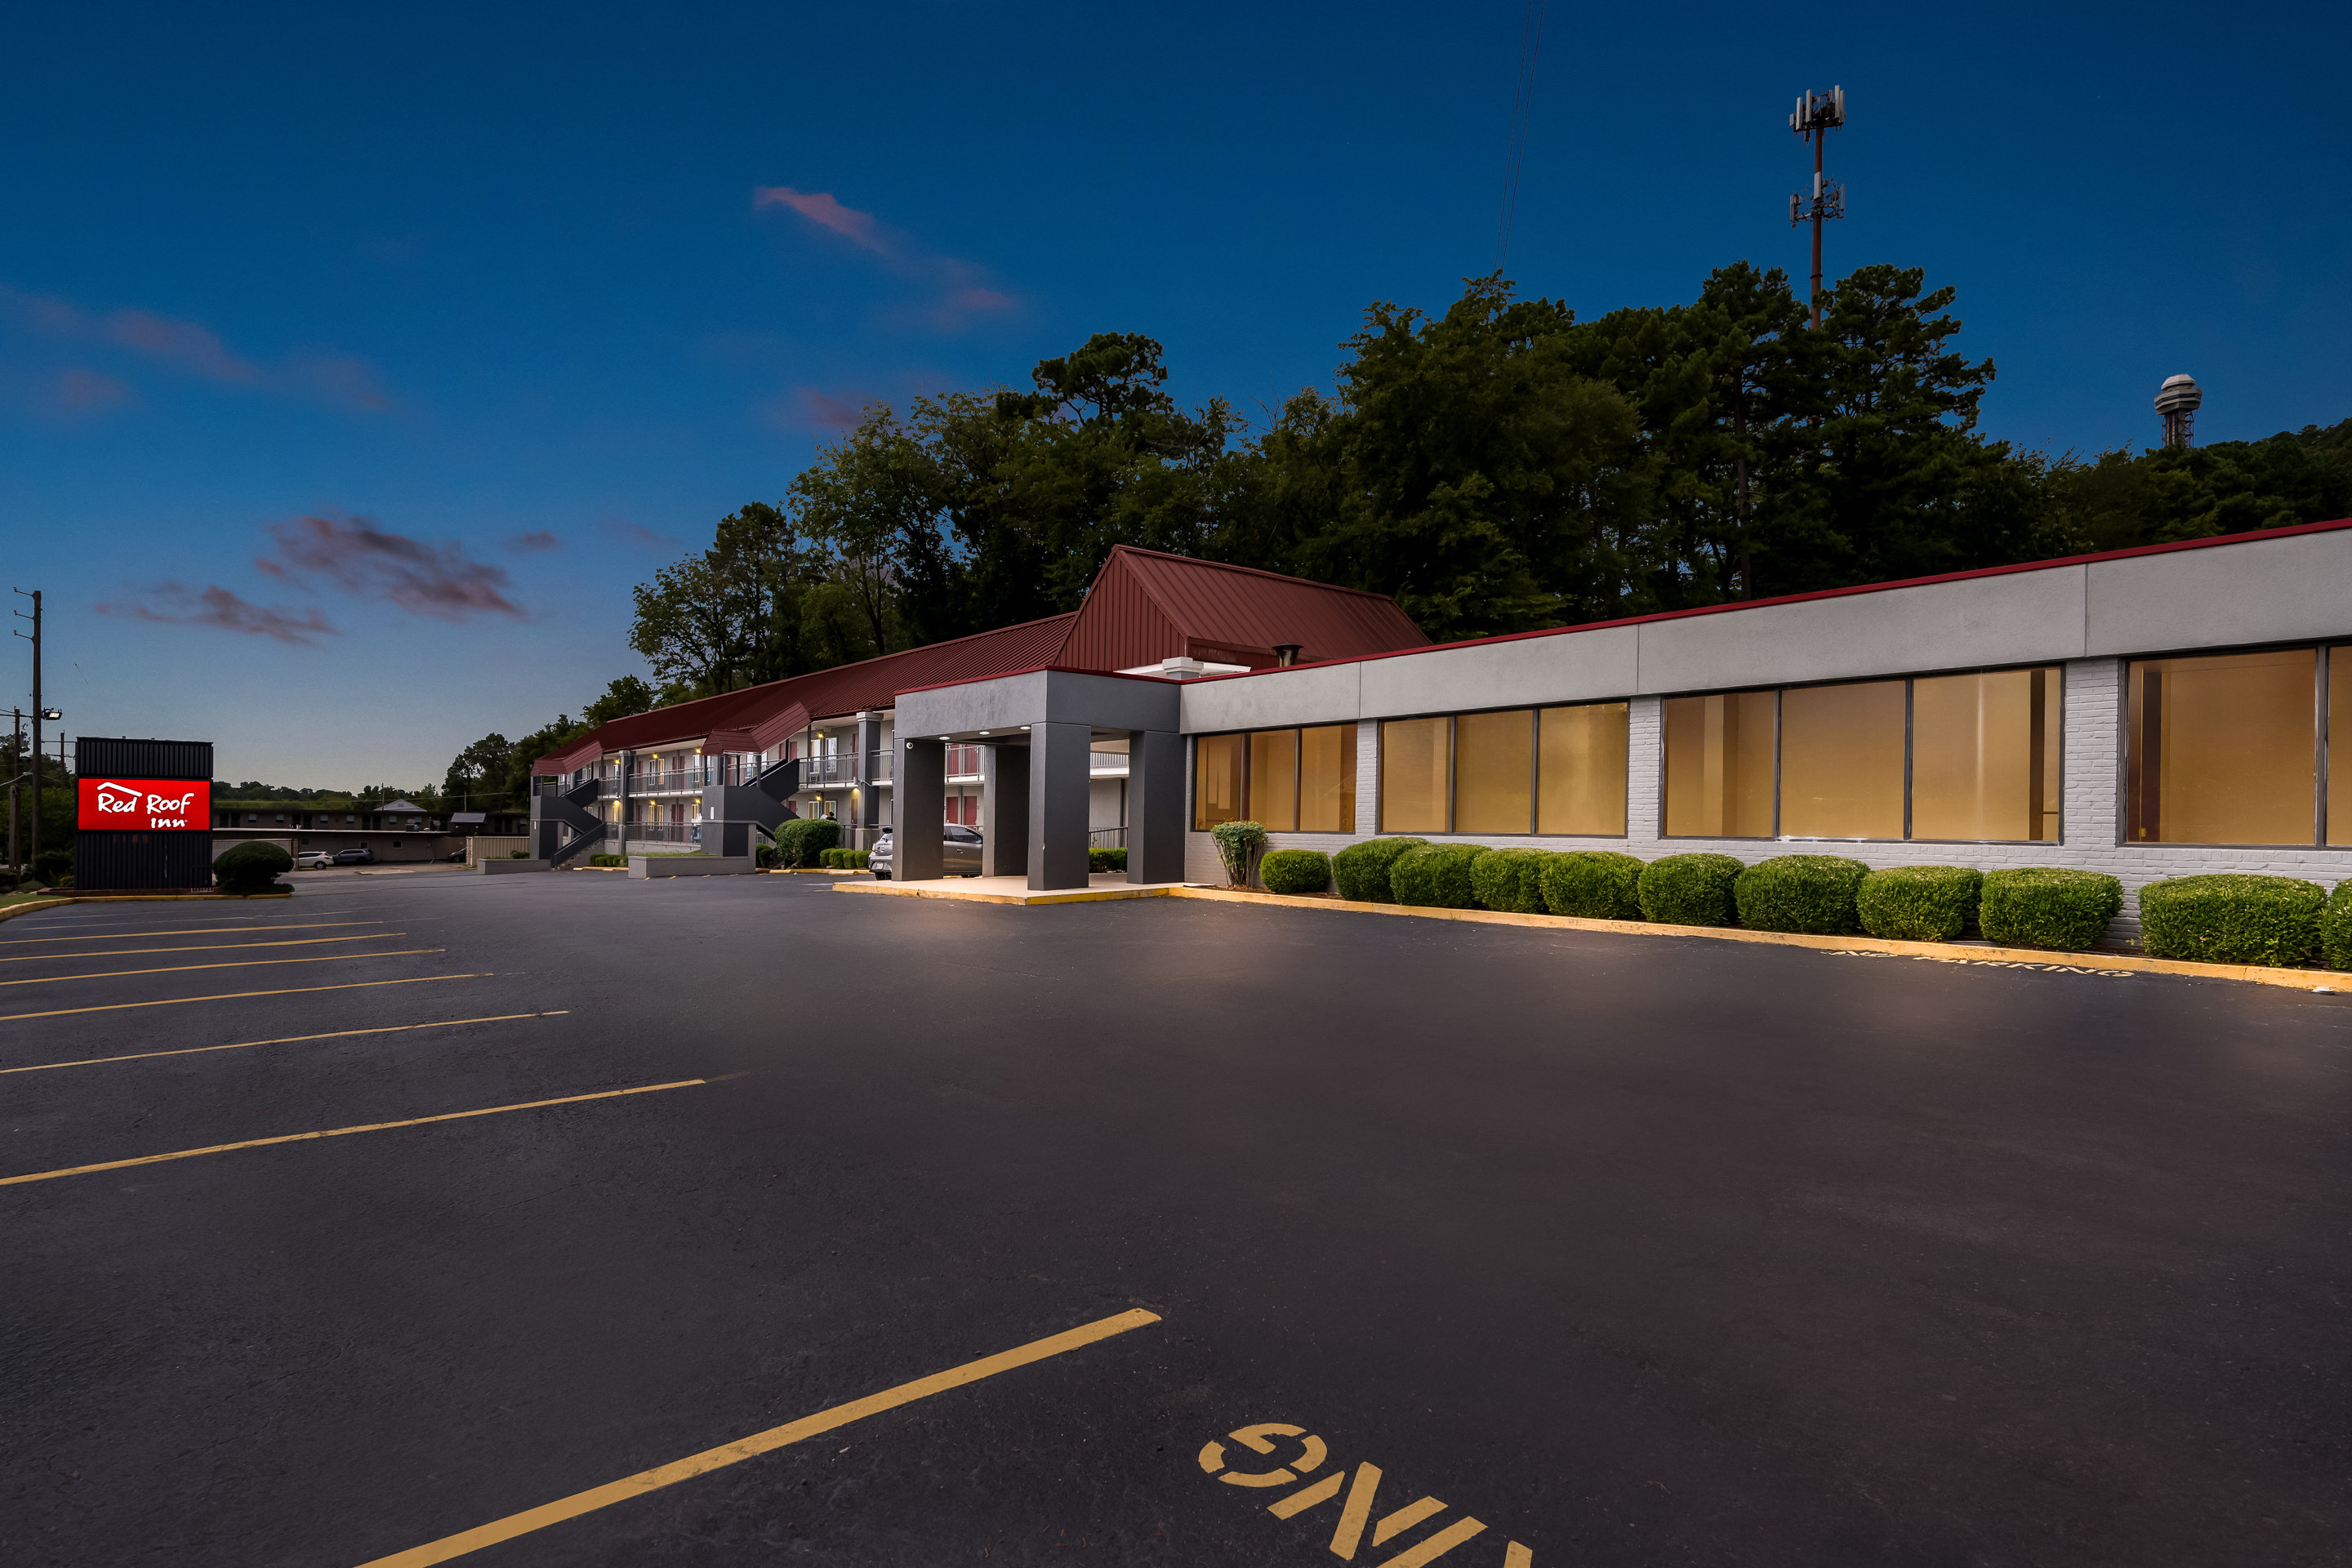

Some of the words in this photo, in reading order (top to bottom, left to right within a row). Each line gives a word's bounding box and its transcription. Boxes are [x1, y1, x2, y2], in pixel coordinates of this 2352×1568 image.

[98, 793, 137, 813] Red
[146, 793, 194, 814] Roof
[1912, 956, 2135, 978] PARKING
[1198, 1423, 1533, 1568] ING
